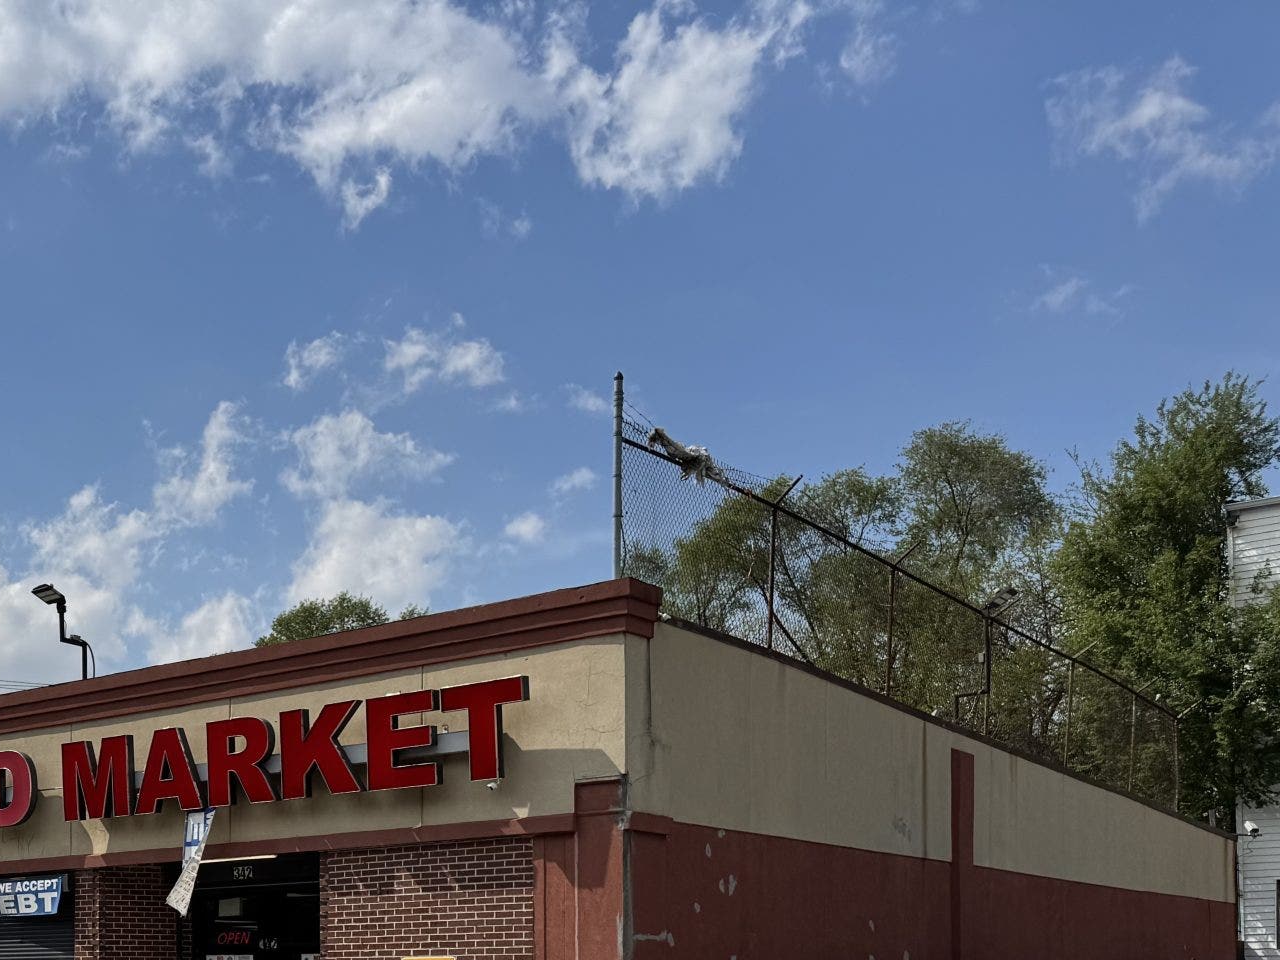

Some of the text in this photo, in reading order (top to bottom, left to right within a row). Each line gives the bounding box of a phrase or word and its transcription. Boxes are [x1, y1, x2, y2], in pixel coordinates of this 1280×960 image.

[60, 675, 530, 823] MARKET
[15, 878, 59, 893] ACCEPT
[217, 931, 252, 945] OPEN
